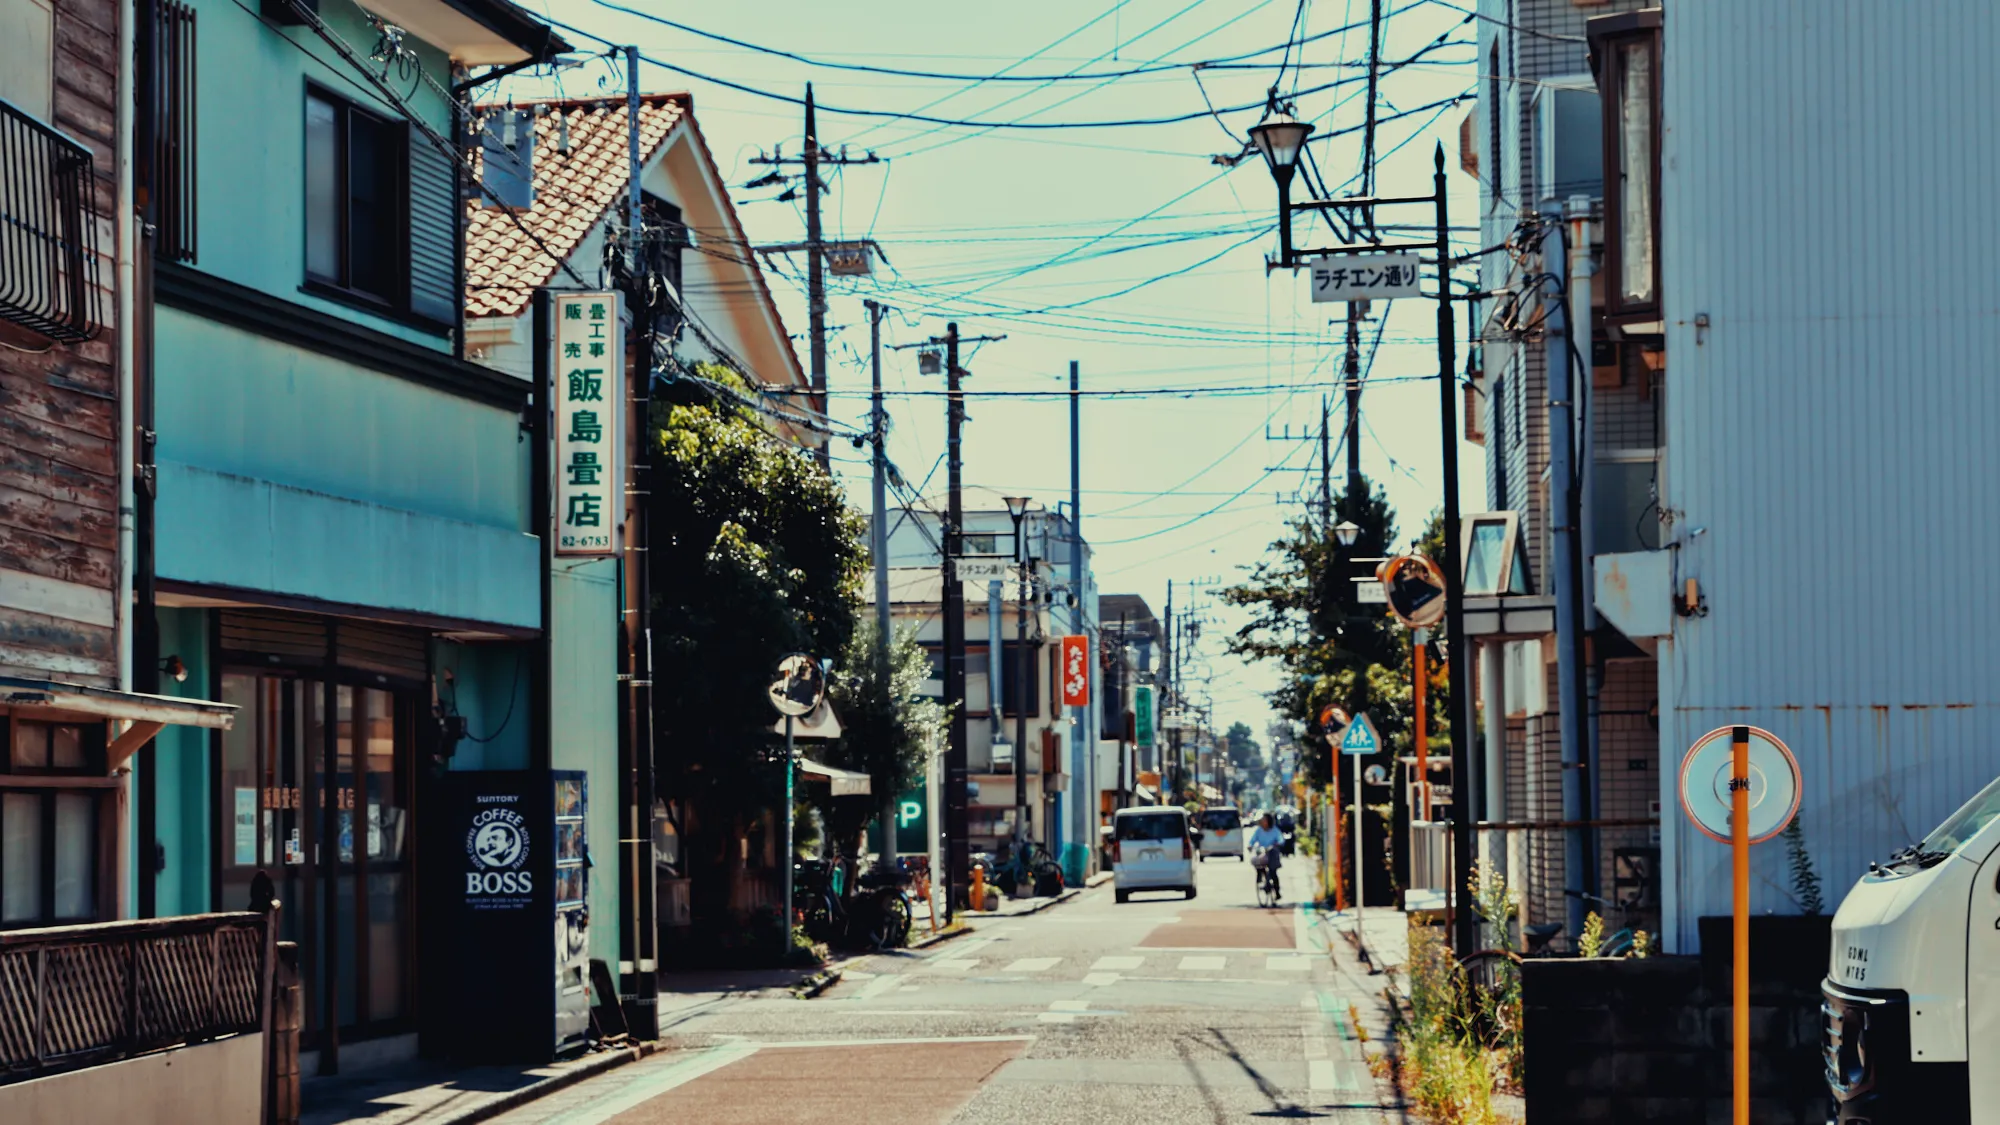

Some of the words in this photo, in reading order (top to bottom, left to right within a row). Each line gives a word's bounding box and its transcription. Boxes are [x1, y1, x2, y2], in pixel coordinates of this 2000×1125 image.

[1315, 264, 1415, 291] ラチエン通り
[564, 303, 582, 358] 販売
[588, 303, 606, 358] 畳工事
[566, 368, 604, 527] 飯島畳店
[561, 535, 609, 547] 82-6783
[959, 563, 1005, 575] ラチエン通り
[476, 795, 519, 803] SUNTORY
[472, 808, 524, 827] COFFEE
[900, 801, 922, 828] P
[466, 871, 533, 894] BOSS
